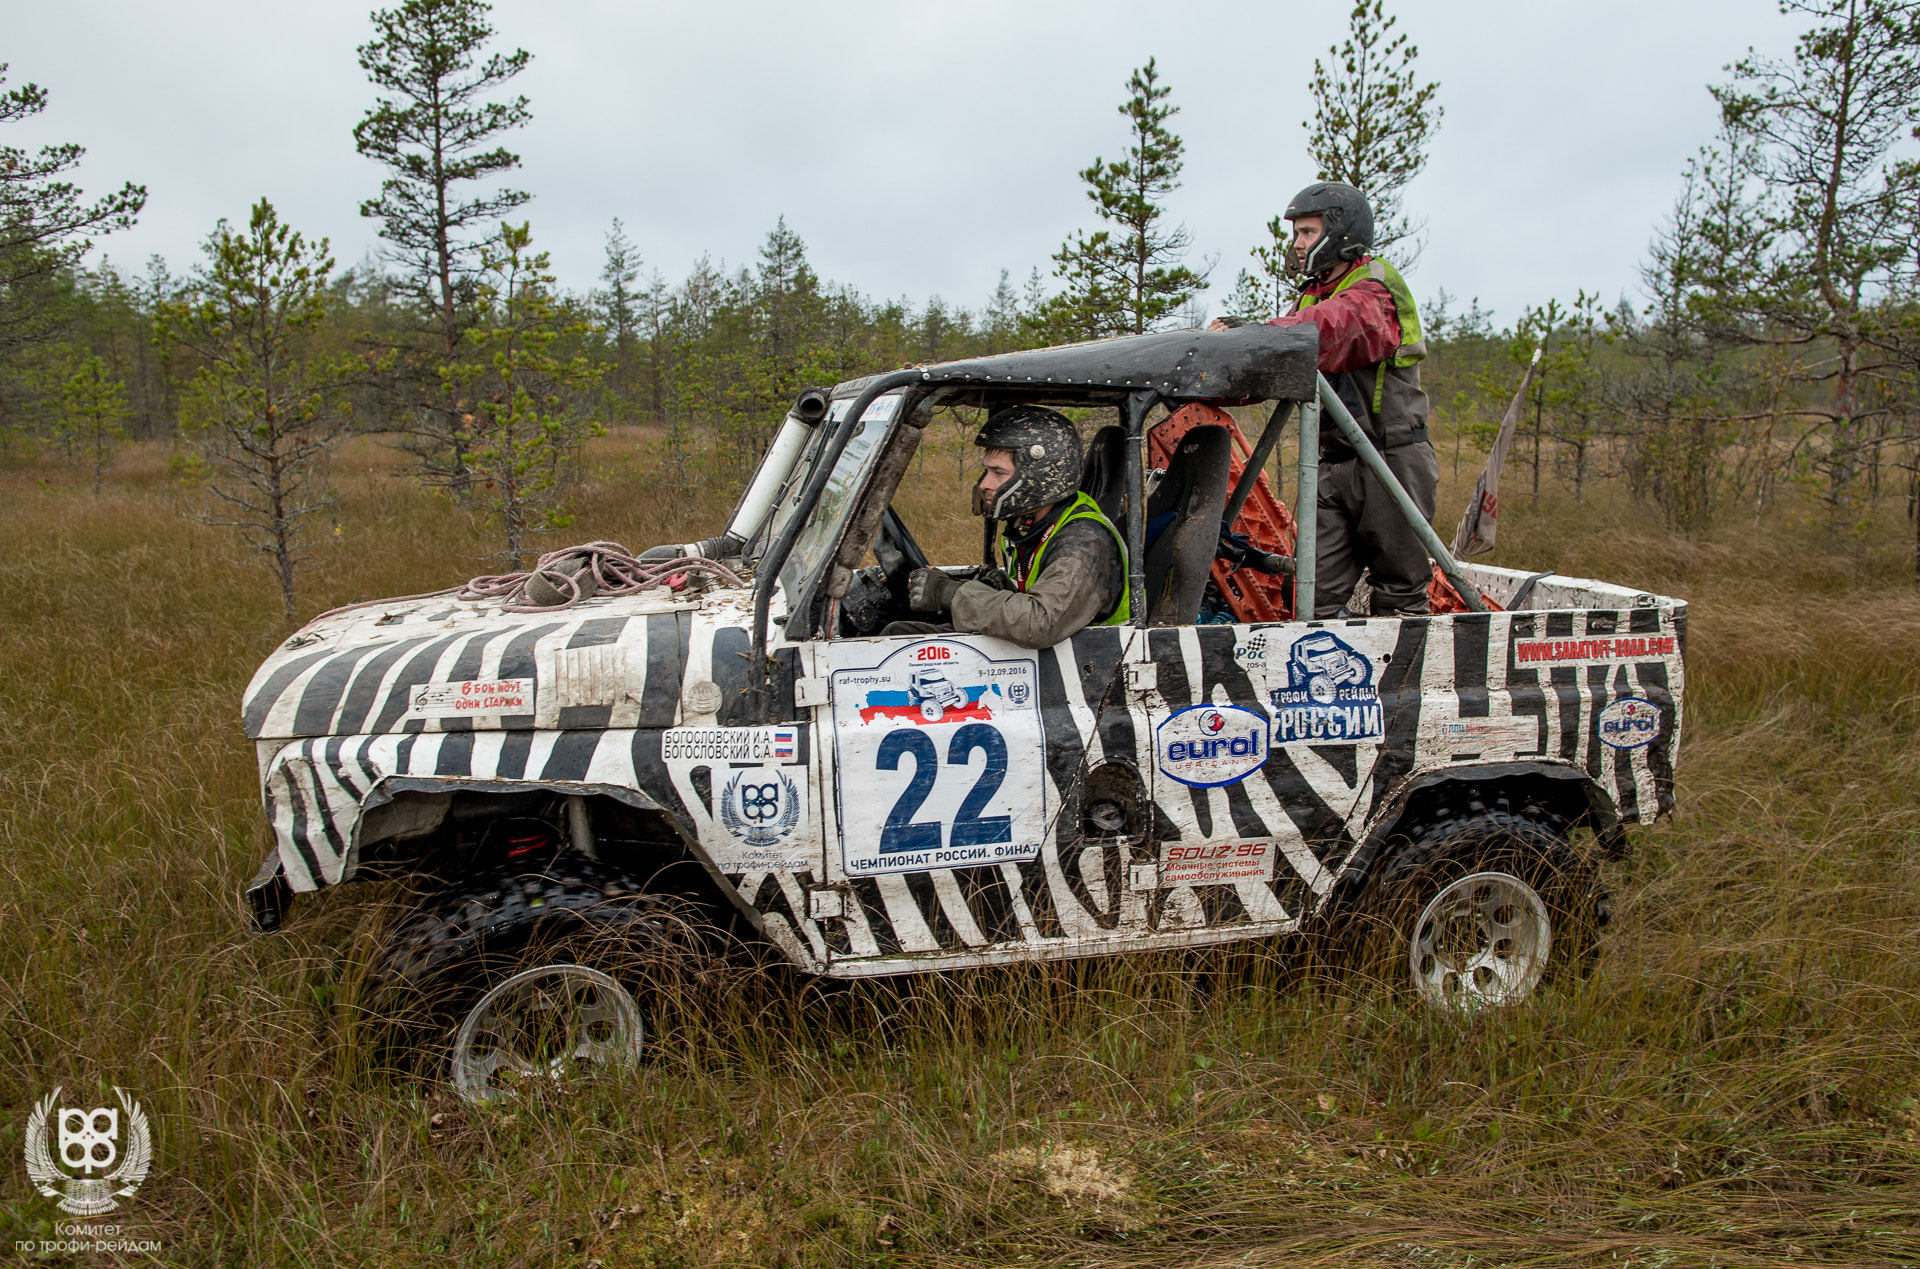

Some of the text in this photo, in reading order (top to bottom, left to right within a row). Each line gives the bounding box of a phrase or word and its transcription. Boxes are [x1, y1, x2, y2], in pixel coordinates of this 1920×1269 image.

[917, 646, 951, 661] 2016
[1517, 636, 1674, 662] WWW.SARATOFF-ROAD.COM
[978, 667, 1027, 677] 9-12.09.2016
[1246, 661, 1267, 669] ros-a
[838, 675, 891, 686] raf-trophy.su
[462, 681, 473, 696] В
[1273, 686, 1376, 704] ТРОФИ РЕЙДЫ
[1280, 705, 1380, 740] РОССИИ
[664, 730, 773, 744] БОГОСЛОВСКИЙ И.А.
[664, 744, 774, 760] БОГОСЛОВСКИЙ С.А.
[1167, 729, 1260, 763] eurol
[1167, 757, 1259, 771] LUBRICANTS
[875, 723, 1012, 855] 22
[741, 851, 783, 860] Комитет
[850, 853, 931, 870] ЧЕМПИОНАТ
[732, 860, 809, 871] трофи-рейдам
[1166, 860, 1260, 872] Моечные системы
[1164, 868, 1265, 882] самообслуживания
